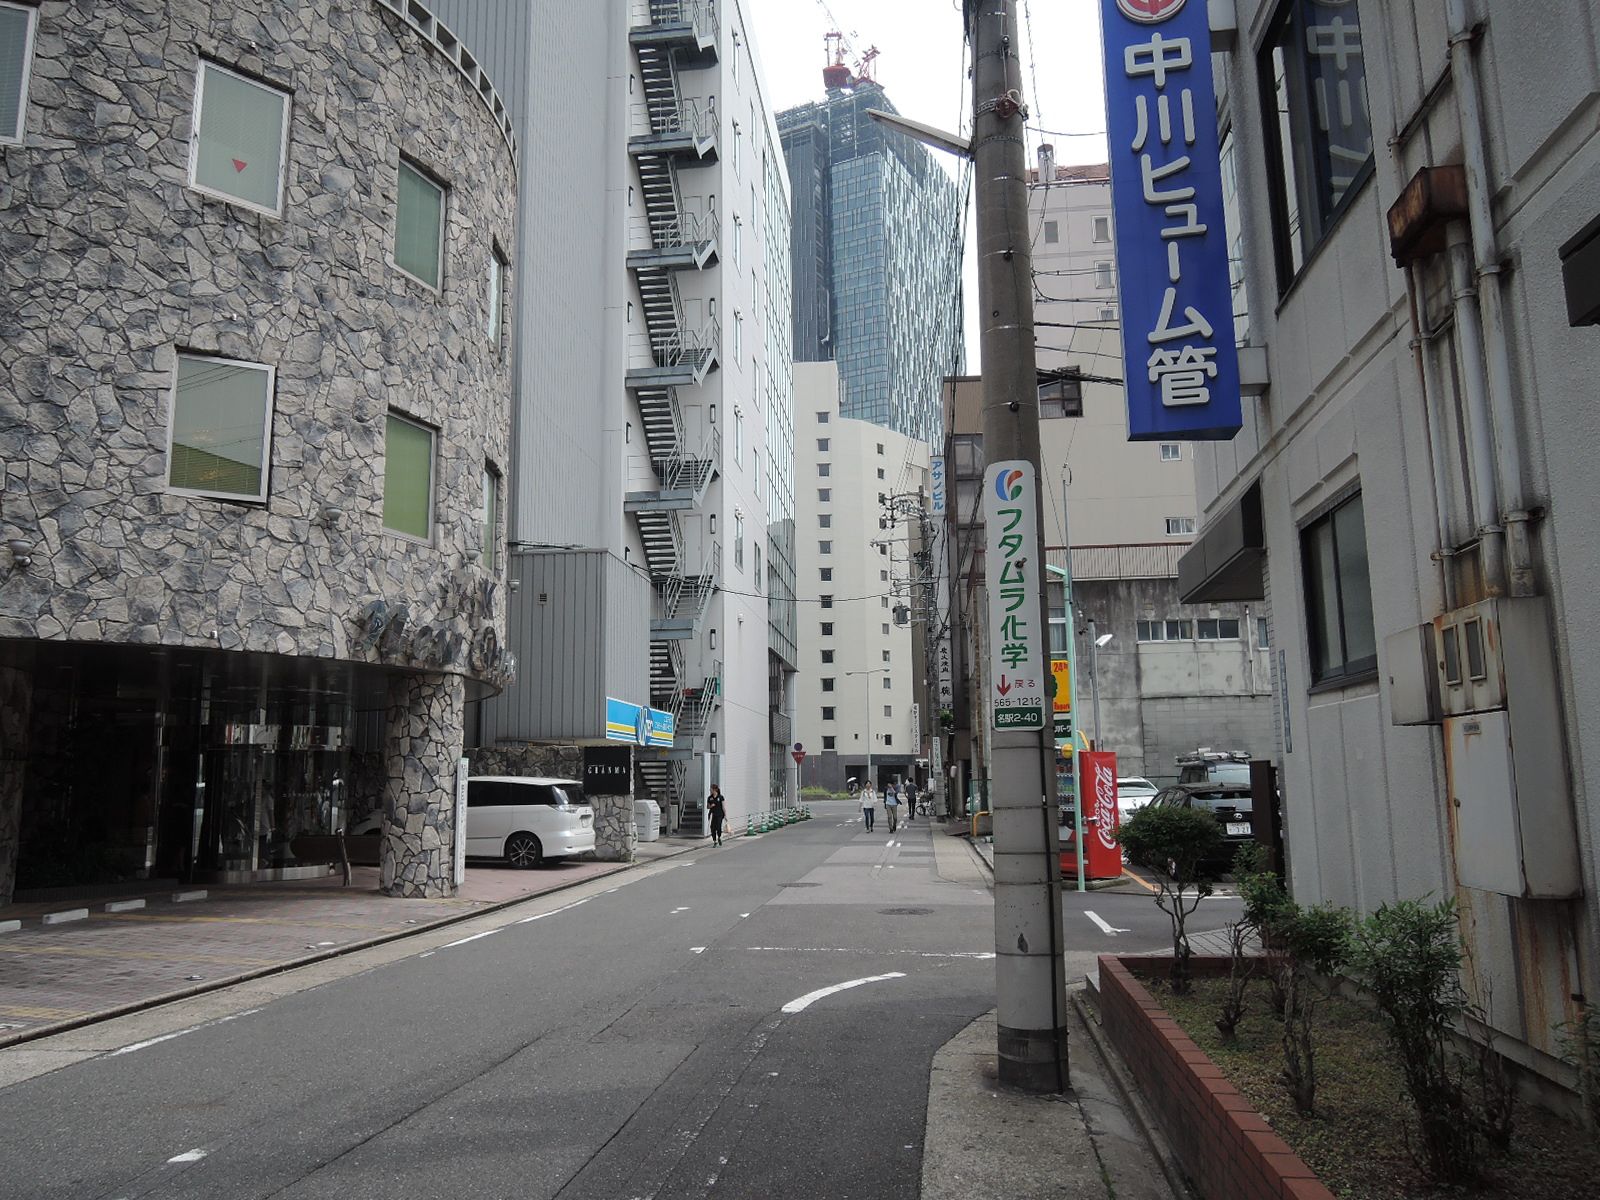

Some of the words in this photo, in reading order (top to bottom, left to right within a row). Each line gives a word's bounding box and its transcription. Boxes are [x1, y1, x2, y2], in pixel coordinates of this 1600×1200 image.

[1124, 32, 1218, 408] 中川ヒューム管
[931, 461, 944, 510] アサノビル
[996, 508, 1028, 670] フタムラ化学
[994, 697, 1042, 708] 565-1212
[1014, 680, 1036, 689] 戻る
[997, 713, 1039, 723] 名駅2-40
[1095, 762, 1117, 850] Coca-Cola
